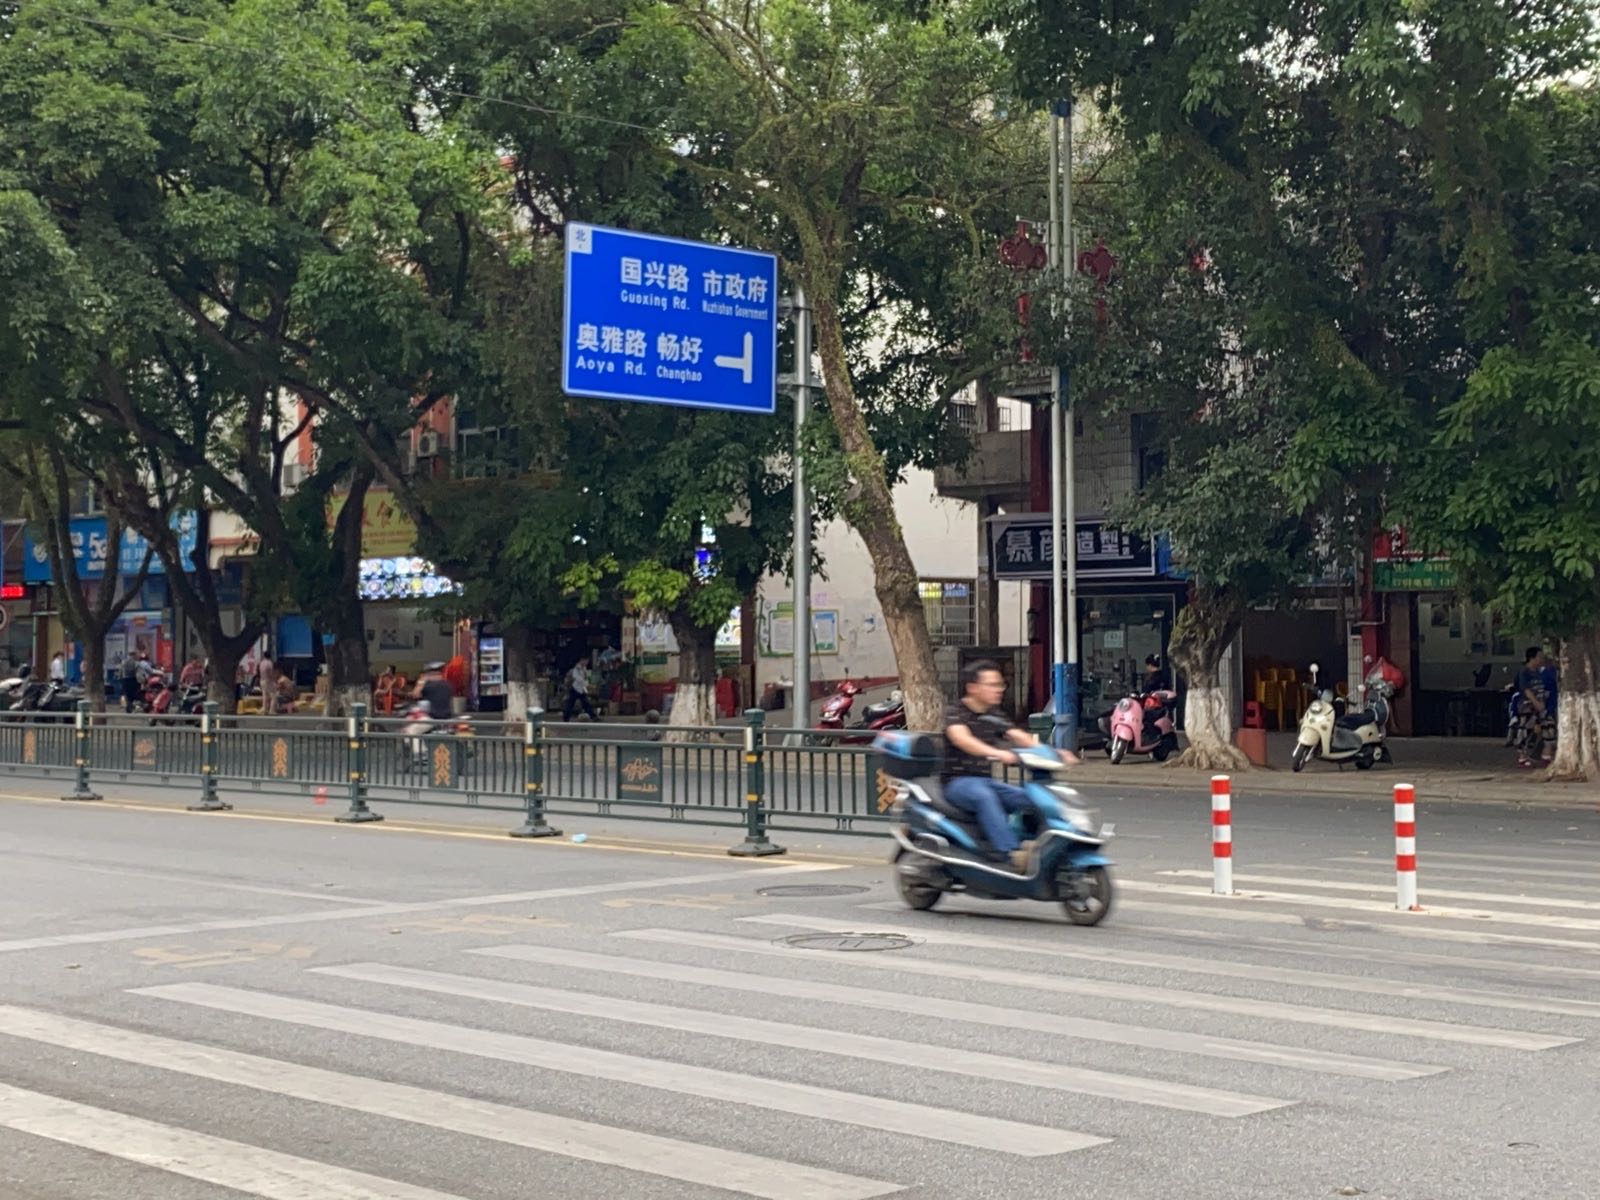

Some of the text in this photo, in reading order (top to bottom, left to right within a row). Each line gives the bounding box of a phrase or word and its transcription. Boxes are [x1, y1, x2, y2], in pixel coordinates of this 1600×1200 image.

[620, 257, 768, 304] 国兴路 市政府
[620, 289, 668, 311] Guoxing
[673, 296, 690, 311] Rd.
[576, 322, 703, 364] 奥雅路 畅好
[575, 355, 702, 383] Aoya Rd. Changhao
